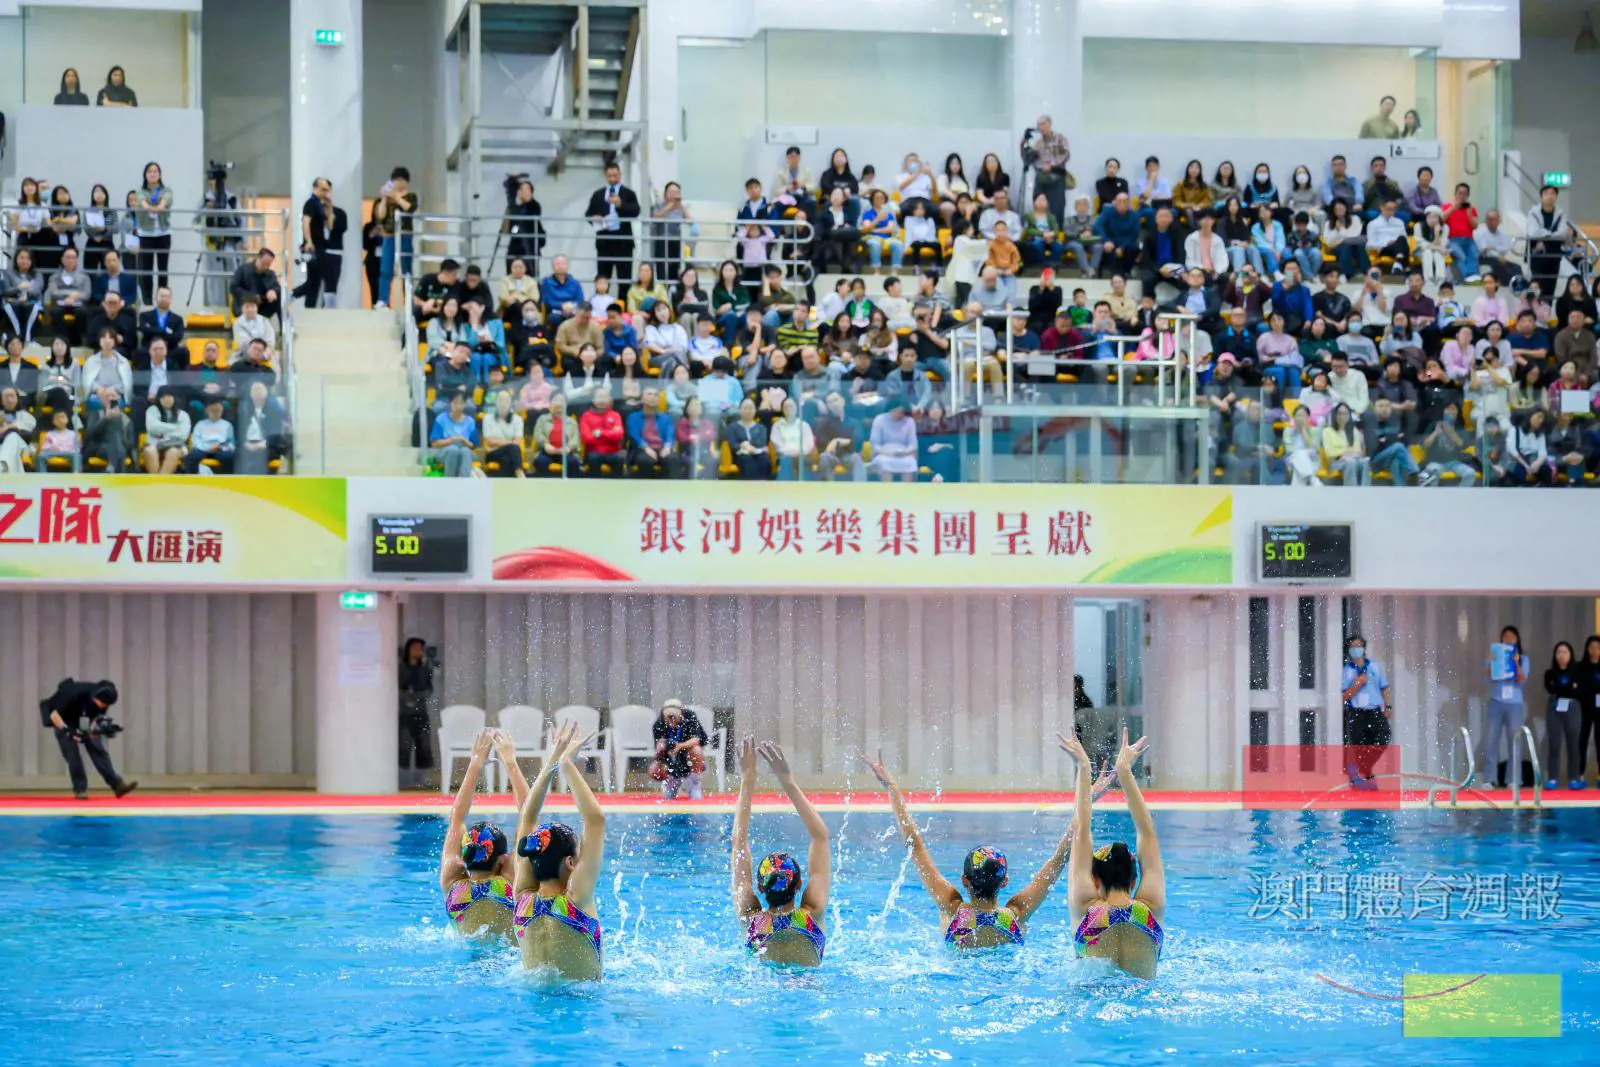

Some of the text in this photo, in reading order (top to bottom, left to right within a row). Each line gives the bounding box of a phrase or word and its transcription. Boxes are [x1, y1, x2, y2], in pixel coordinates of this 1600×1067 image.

[375, 535, 419, 555] 5.00
[640, 507, 1092, 556] 銀河娛樂集團呈獻
[106, 529, 222, 563] 大匯演
[1264, 542, 1306, 561] 5.00
